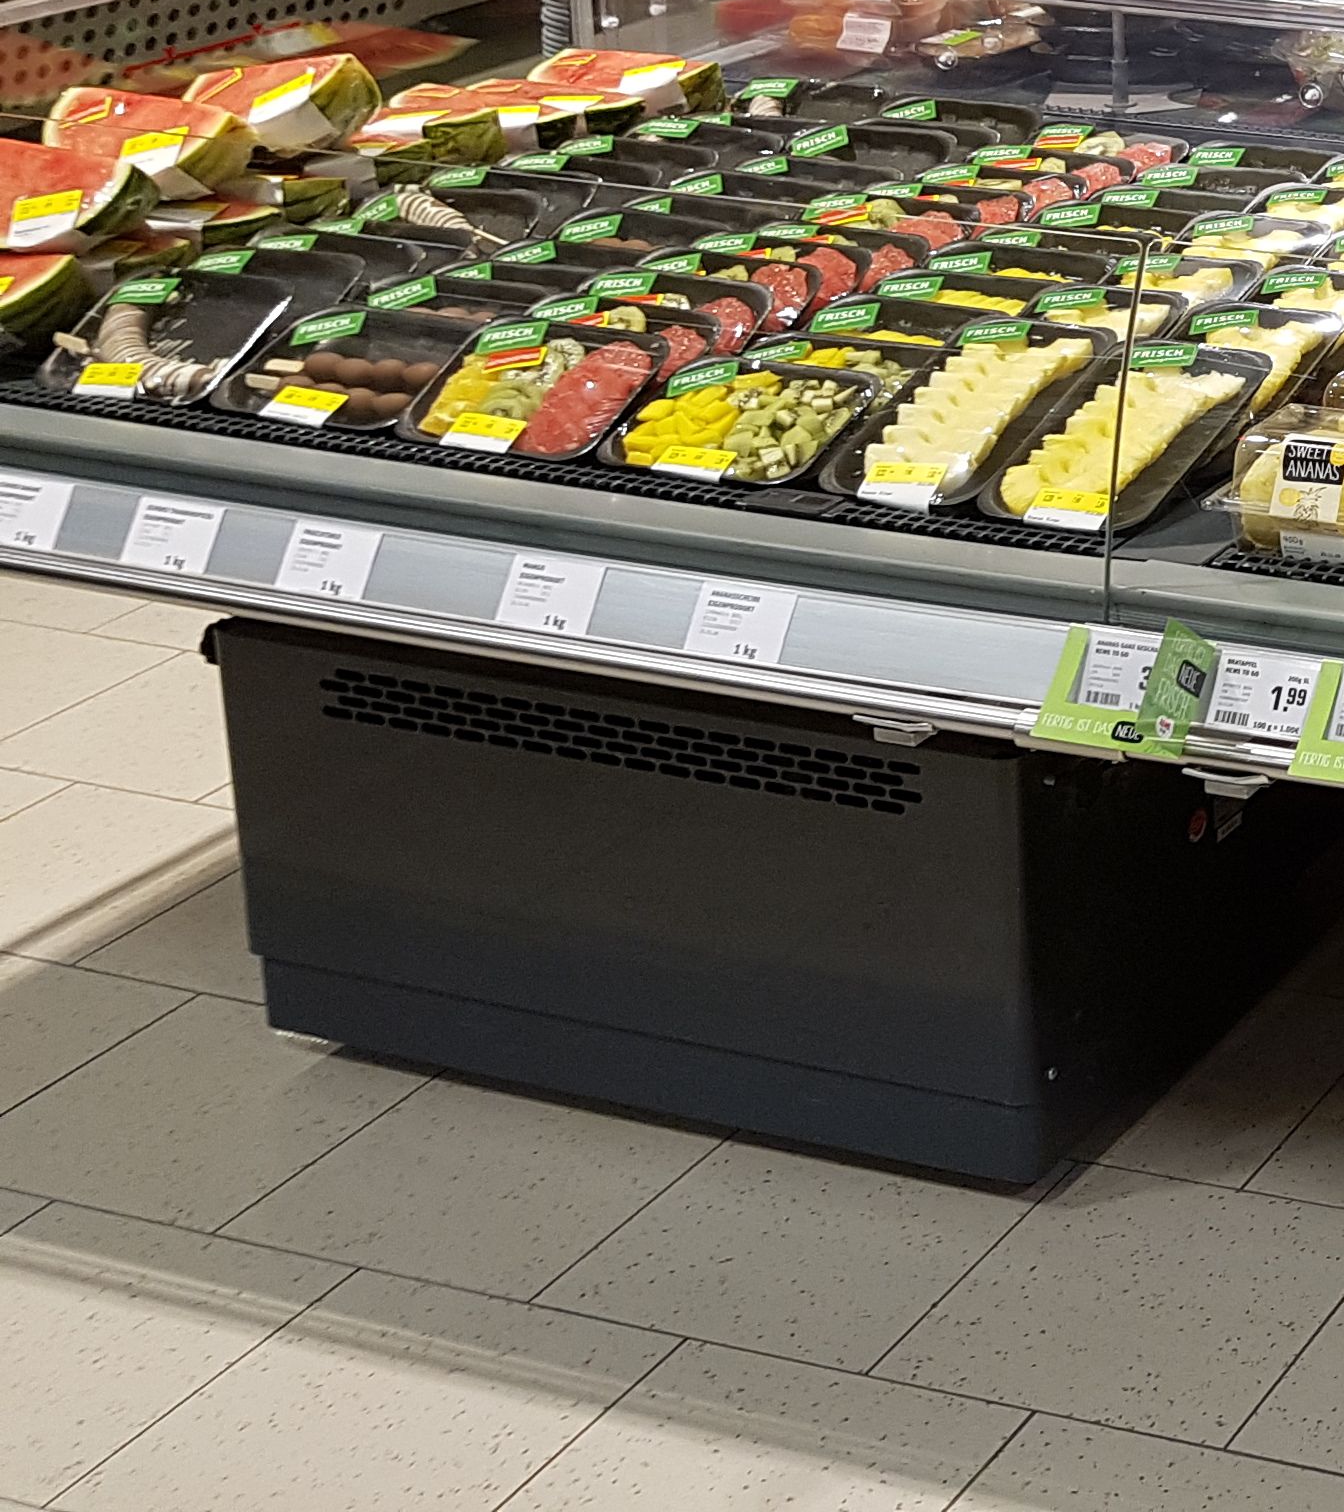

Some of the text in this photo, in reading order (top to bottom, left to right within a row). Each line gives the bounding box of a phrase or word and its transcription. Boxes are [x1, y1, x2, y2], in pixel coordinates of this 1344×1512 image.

[818, 306, 866, 322] FRISCH
[484, 326, 534, 342] FRISCH
[966, 324, 1018, 340] FRISCH
[1132, 347, 1184, 363] FRISCH
[676, 367, 726, 385] FRISCH
[1288, 443, 1332, 459] SWEET
[1285, 459, 1341, 482] ANANAS
[552, 616, 567, 631] kg
[742, 645, 757, 660] kg
[1271, 686, 1307, 712] 1.99
[1077, 717, 1091, 732] IST
[1300, 751, 1329, 768] FERTIG
